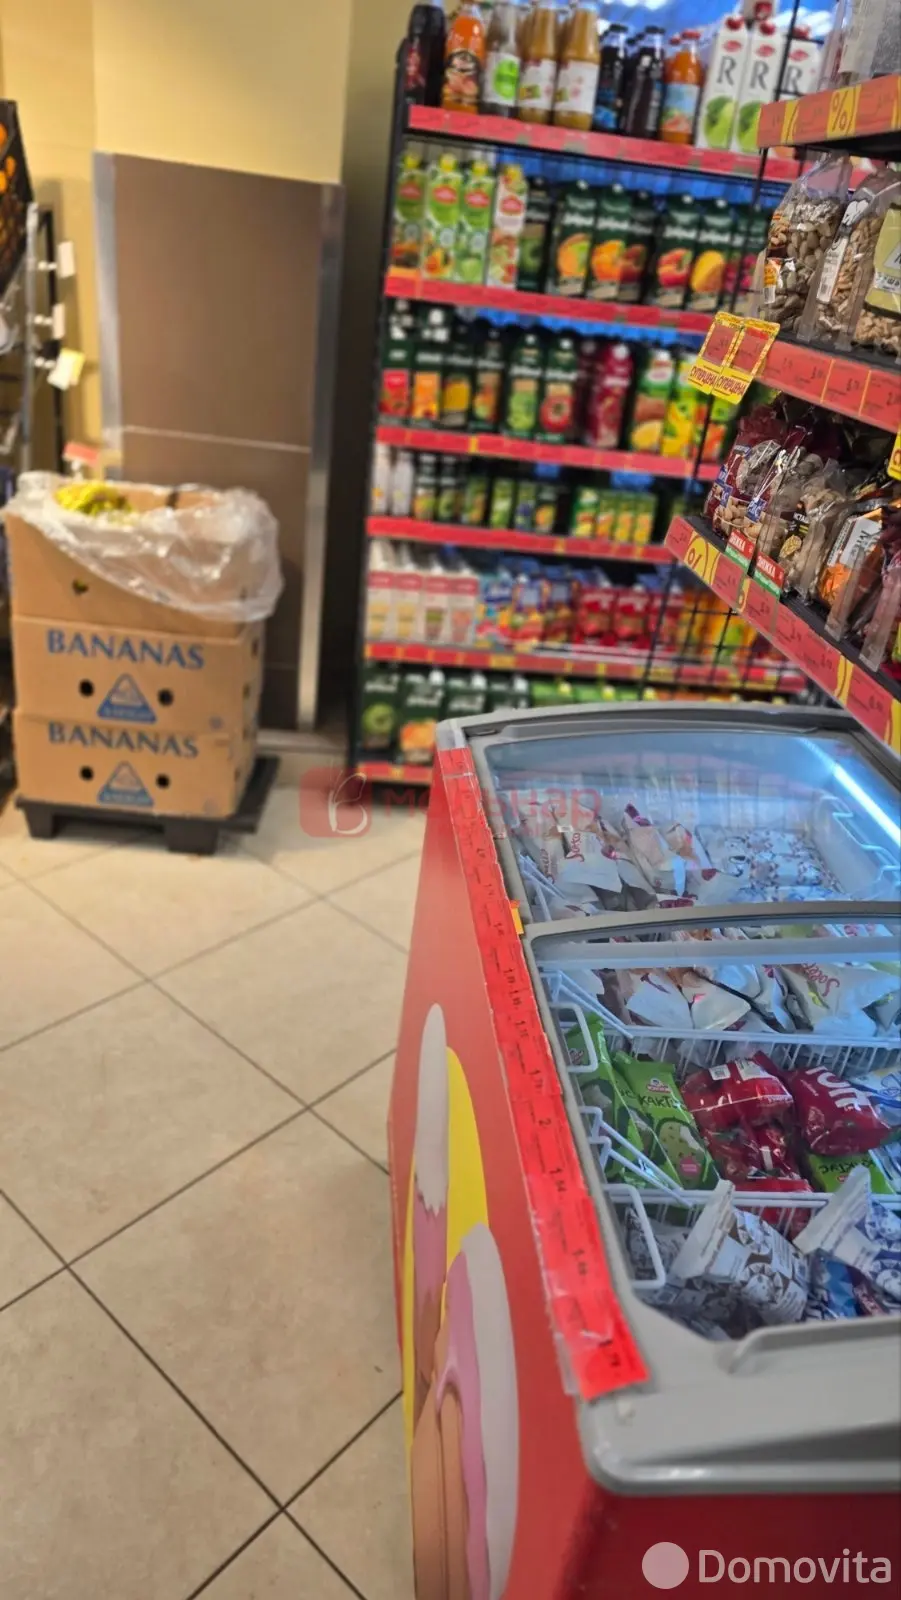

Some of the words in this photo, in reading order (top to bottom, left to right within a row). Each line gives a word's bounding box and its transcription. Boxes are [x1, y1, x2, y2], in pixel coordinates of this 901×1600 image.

[717, 56, 737, 86] R
[749, 60, 770, 90] R
[47, 628, 205, 670] BANANAS
[48, 721, 199, 759] BANANAS
